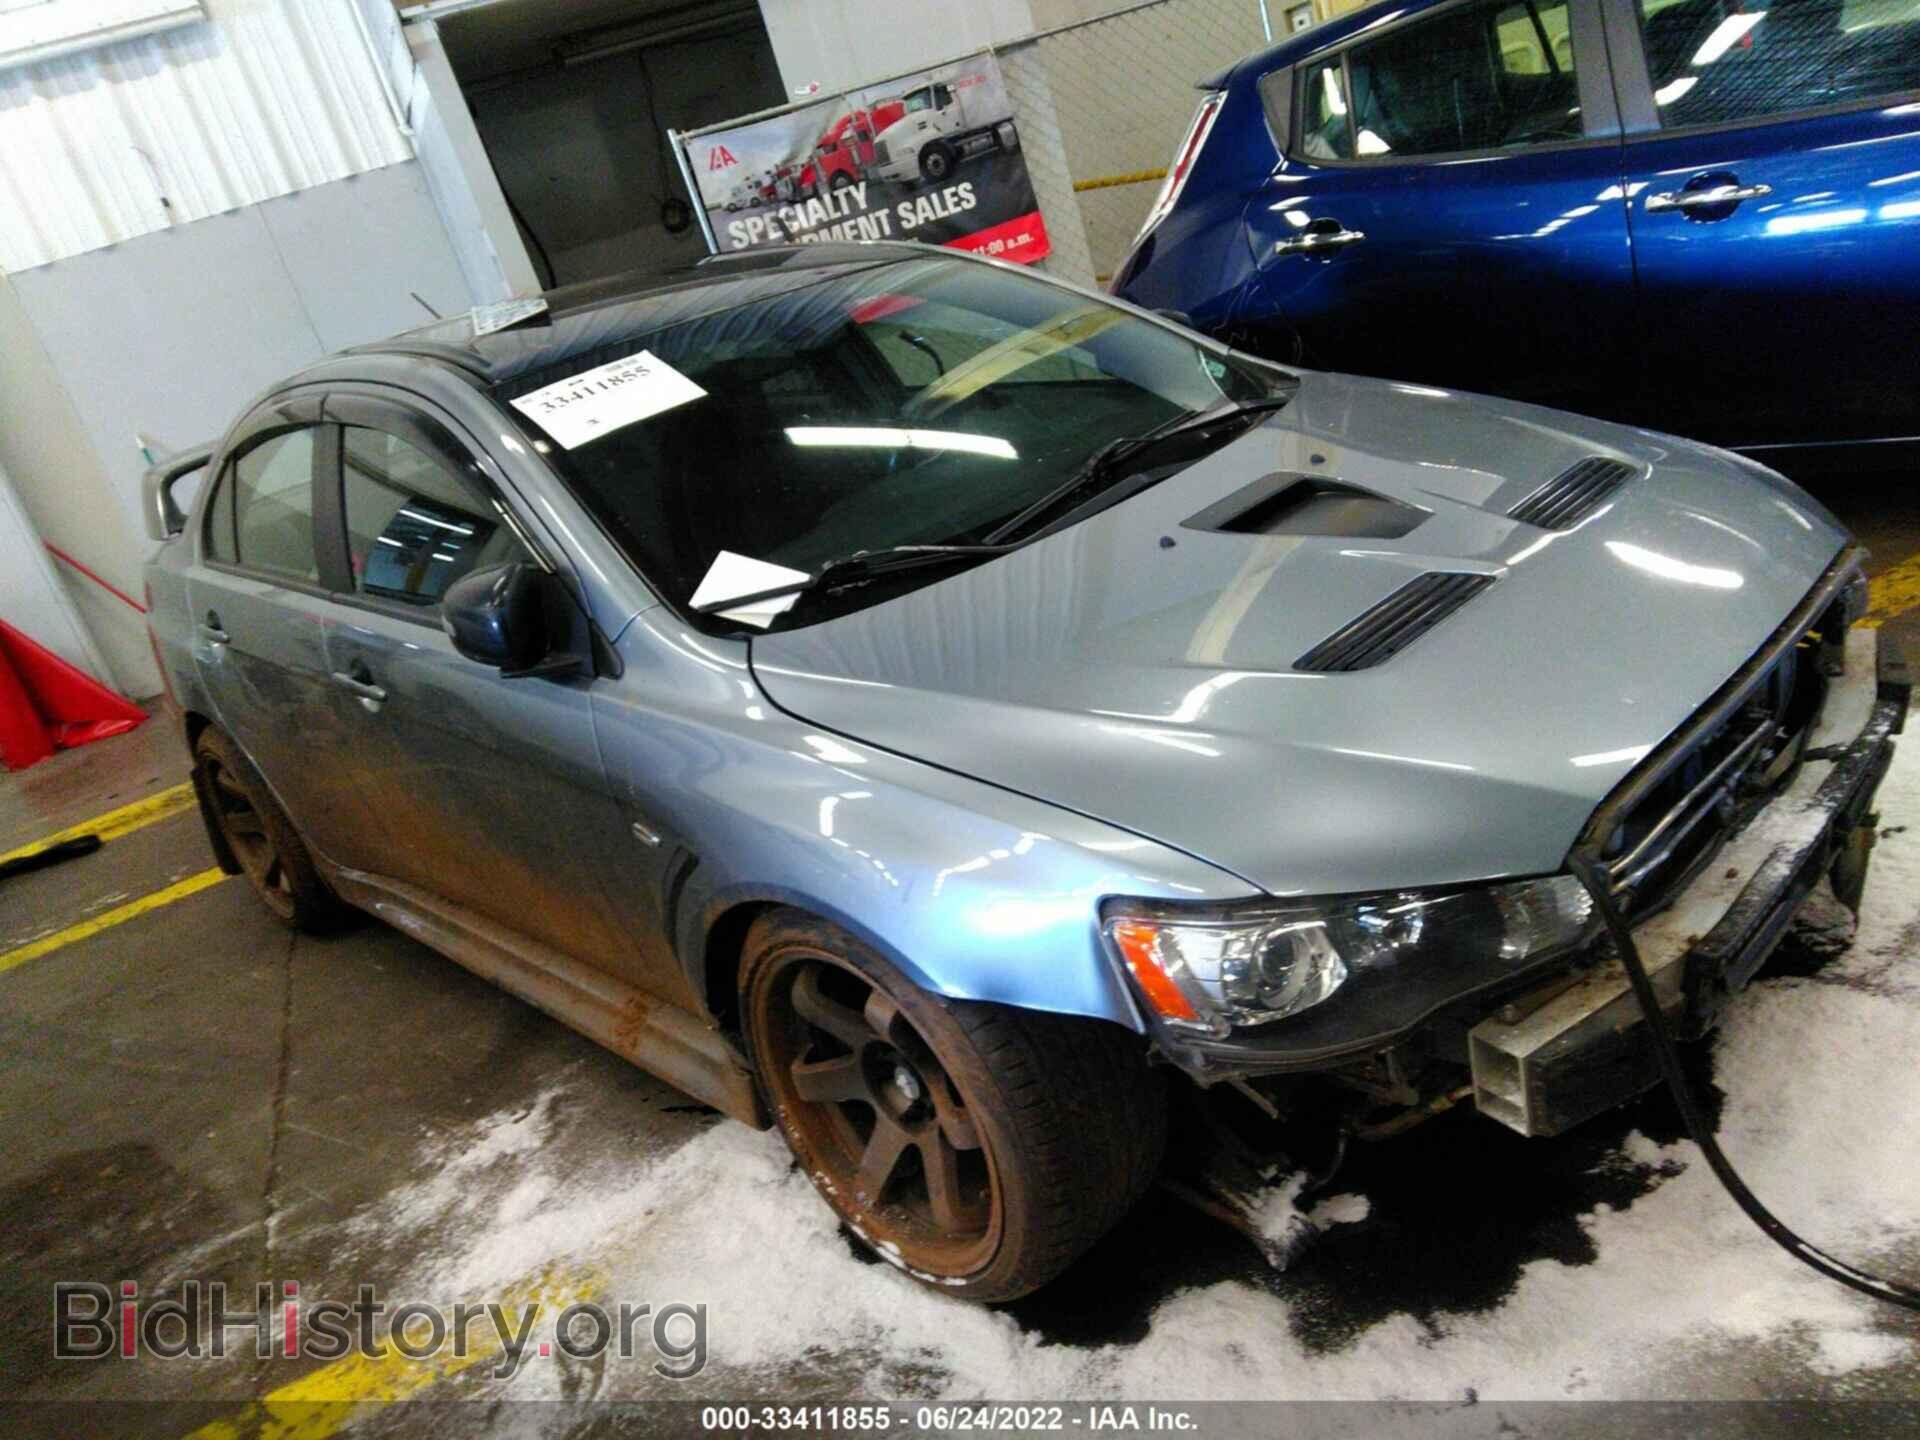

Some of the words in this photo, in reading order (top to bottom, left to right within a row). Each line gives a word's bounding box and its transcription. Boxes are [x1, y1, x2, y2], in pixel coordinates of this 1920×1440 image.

[728, 182, 868, 249] SPECIALTY
[897, 182, 977, 229] SALES
[539, 365, 651, 413] 33411855
